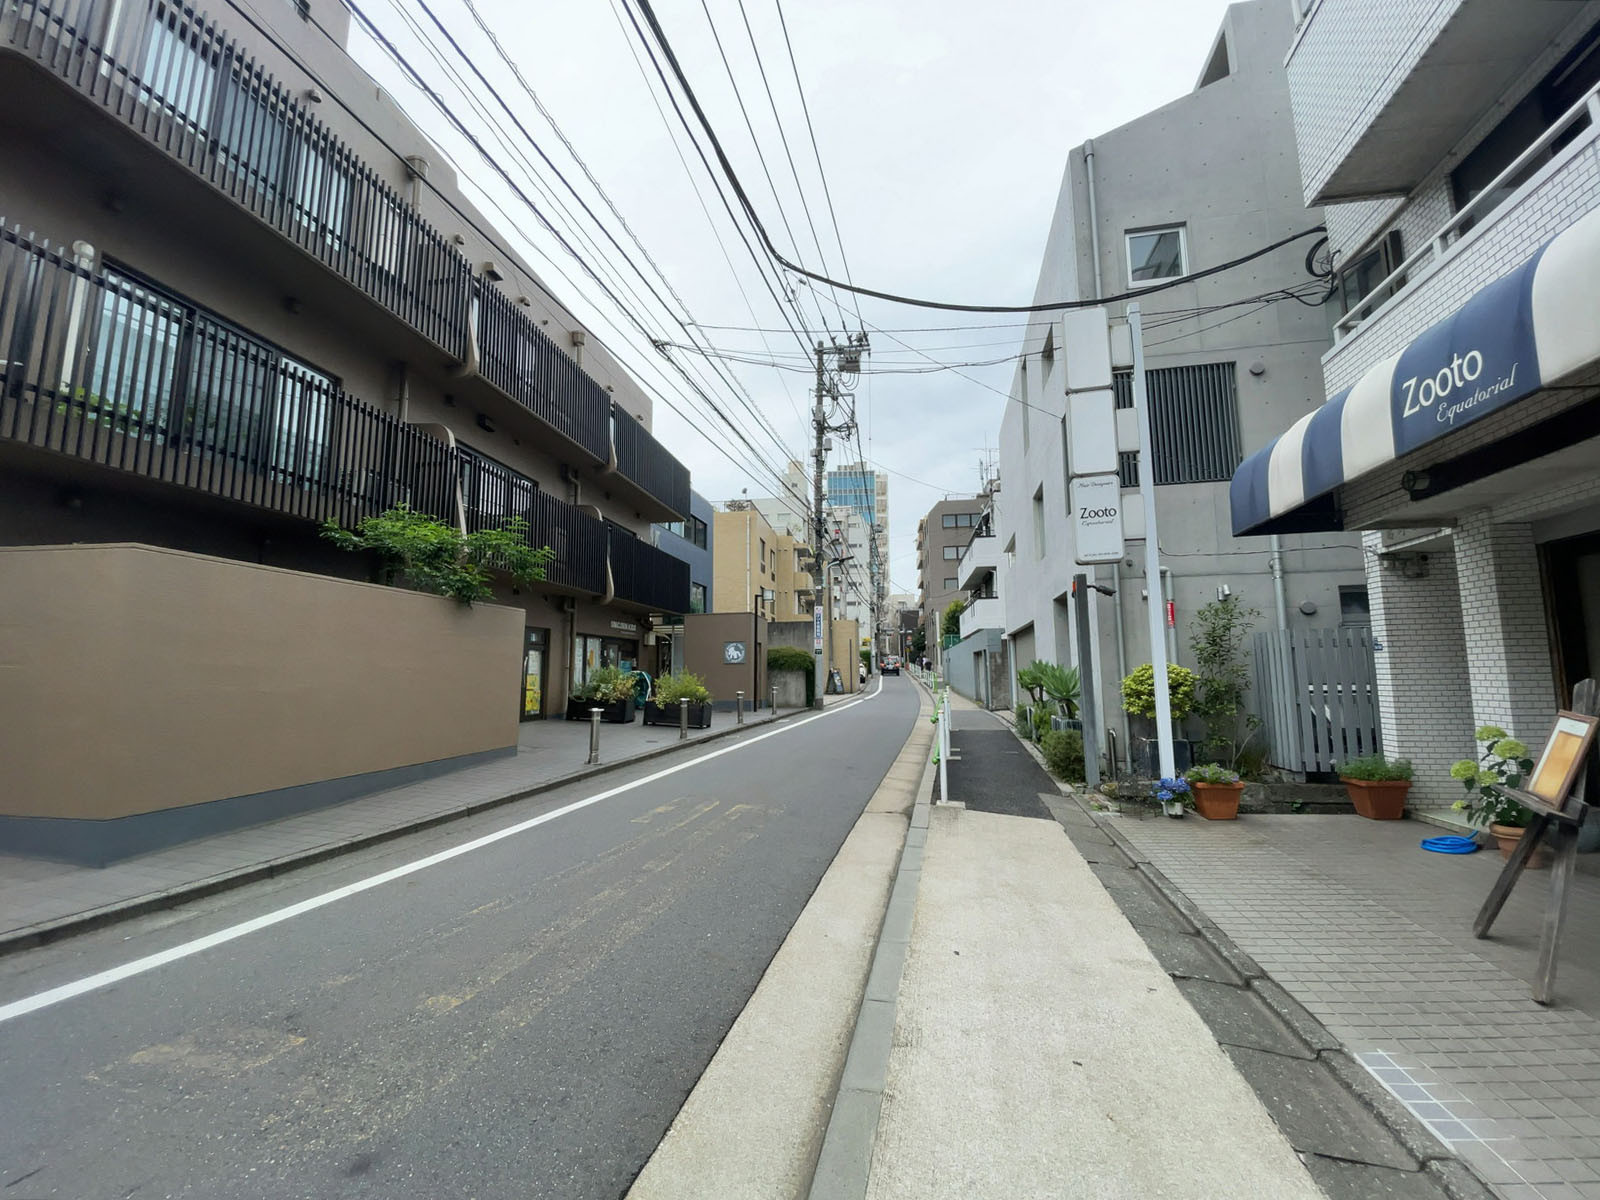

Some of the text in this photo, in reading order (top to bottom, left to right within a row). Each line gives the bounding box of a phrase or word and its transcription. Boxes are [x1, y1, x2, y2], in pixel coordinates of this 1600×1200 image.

[1402, 350, 1483, 418] Zooto
[1436, 362, 1519, 425] Equatorial
[1080, 507, 1117, 519] Zooto
